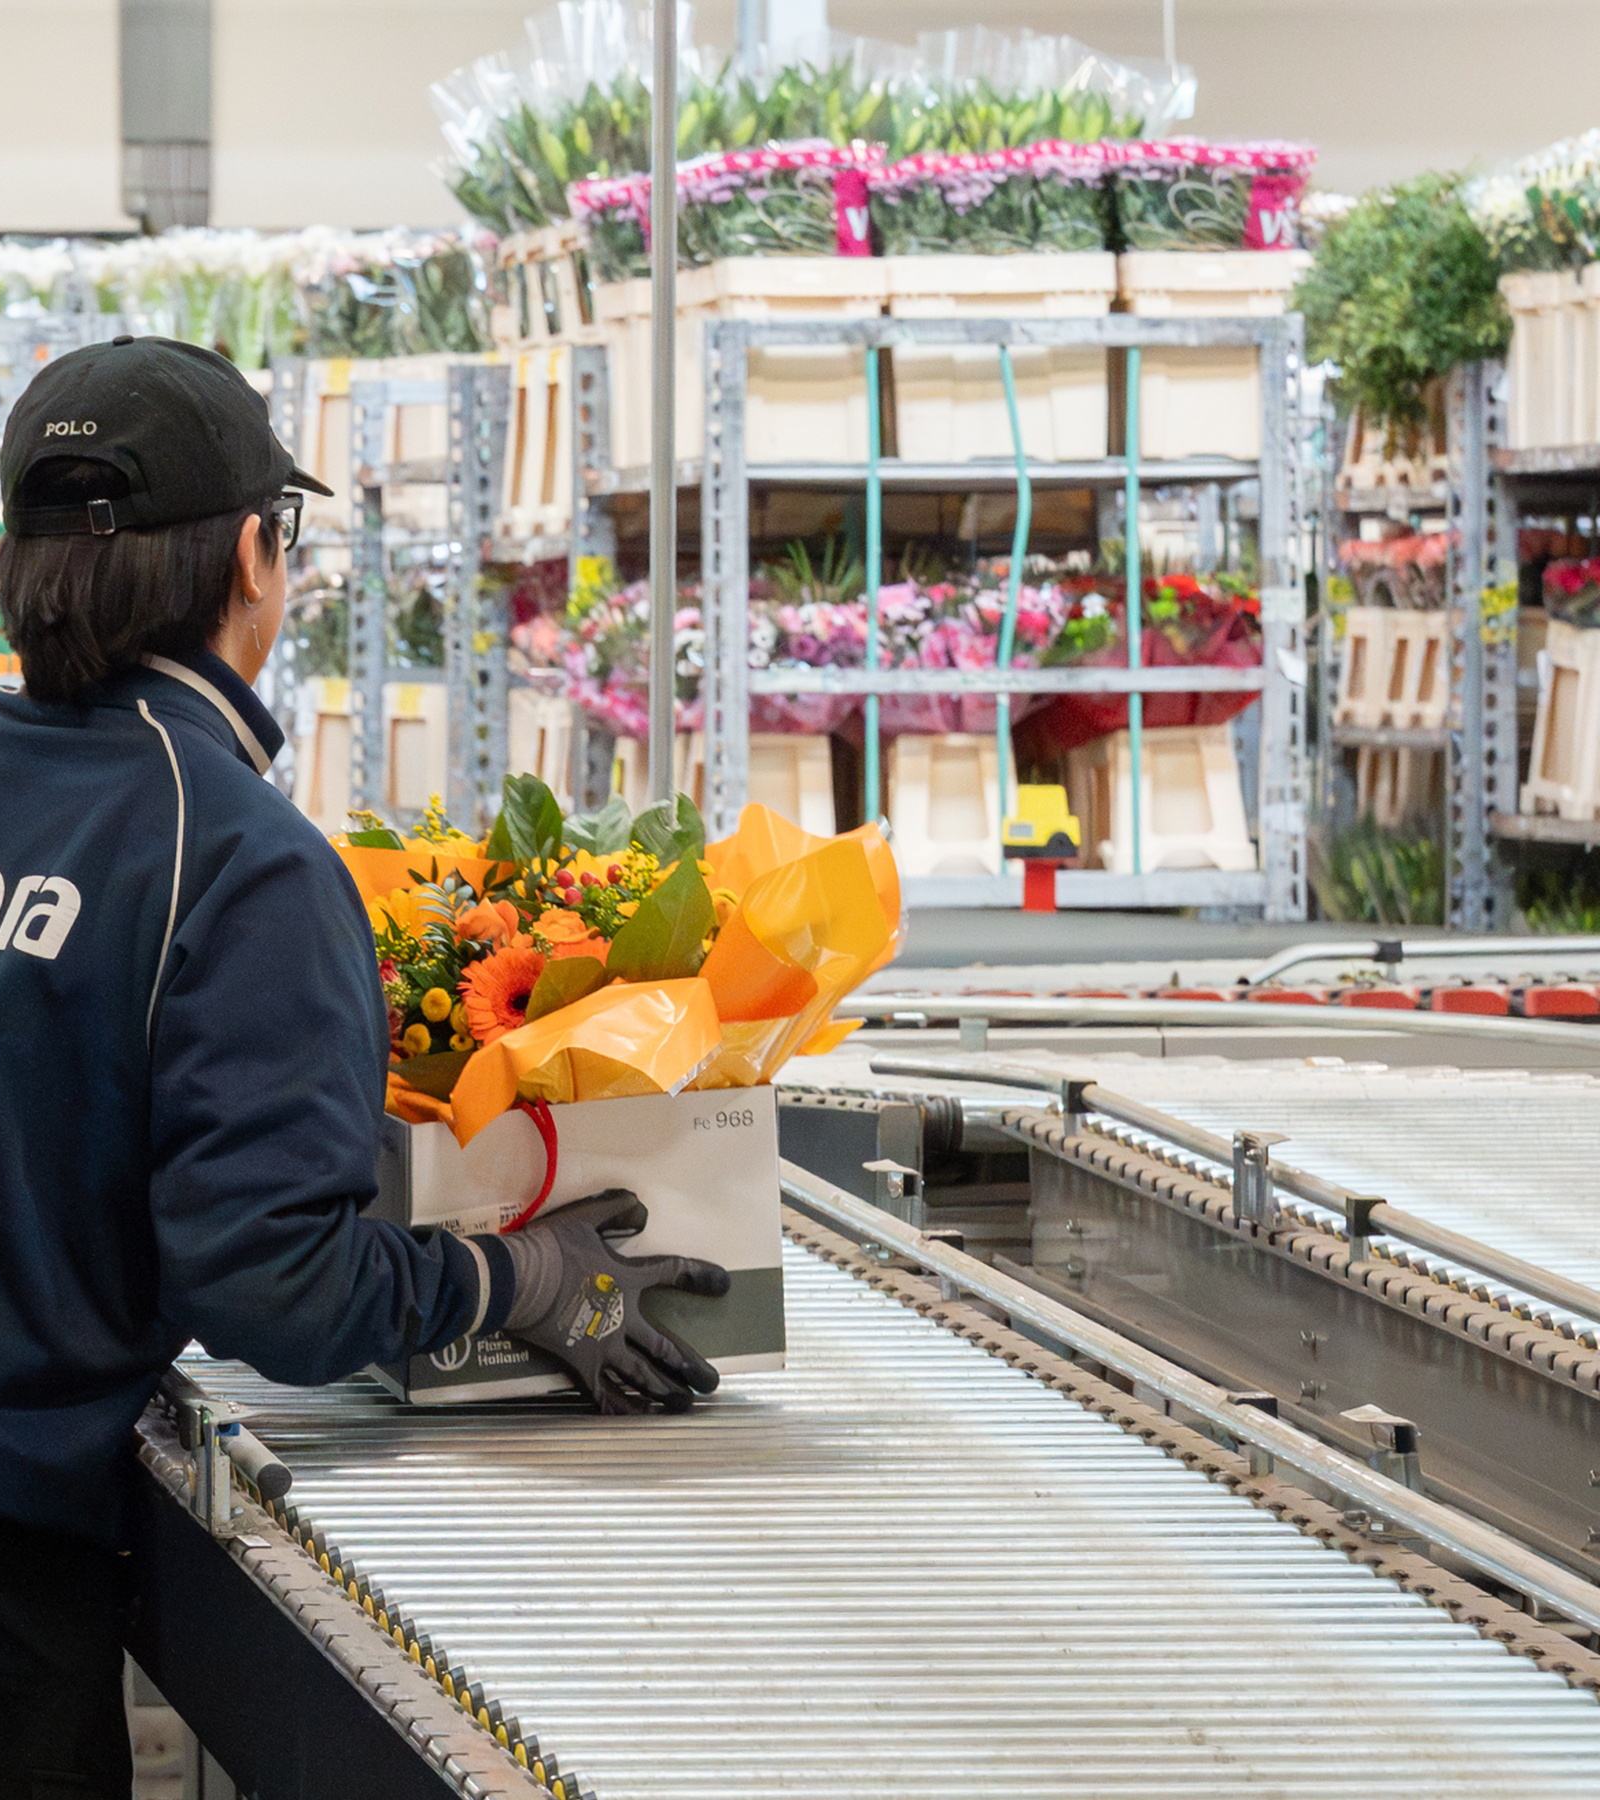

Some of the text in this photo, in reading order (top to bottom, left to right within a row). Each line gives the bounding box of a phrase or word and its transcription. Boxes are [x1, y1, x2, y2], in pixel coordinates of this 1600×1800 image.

[43, 420, 98, 438] POLO
[715, 1108, 754, 1129] 968
[477, 1340, 512, 1352] Flora
[477, 1349, 529, 1366] Holland
